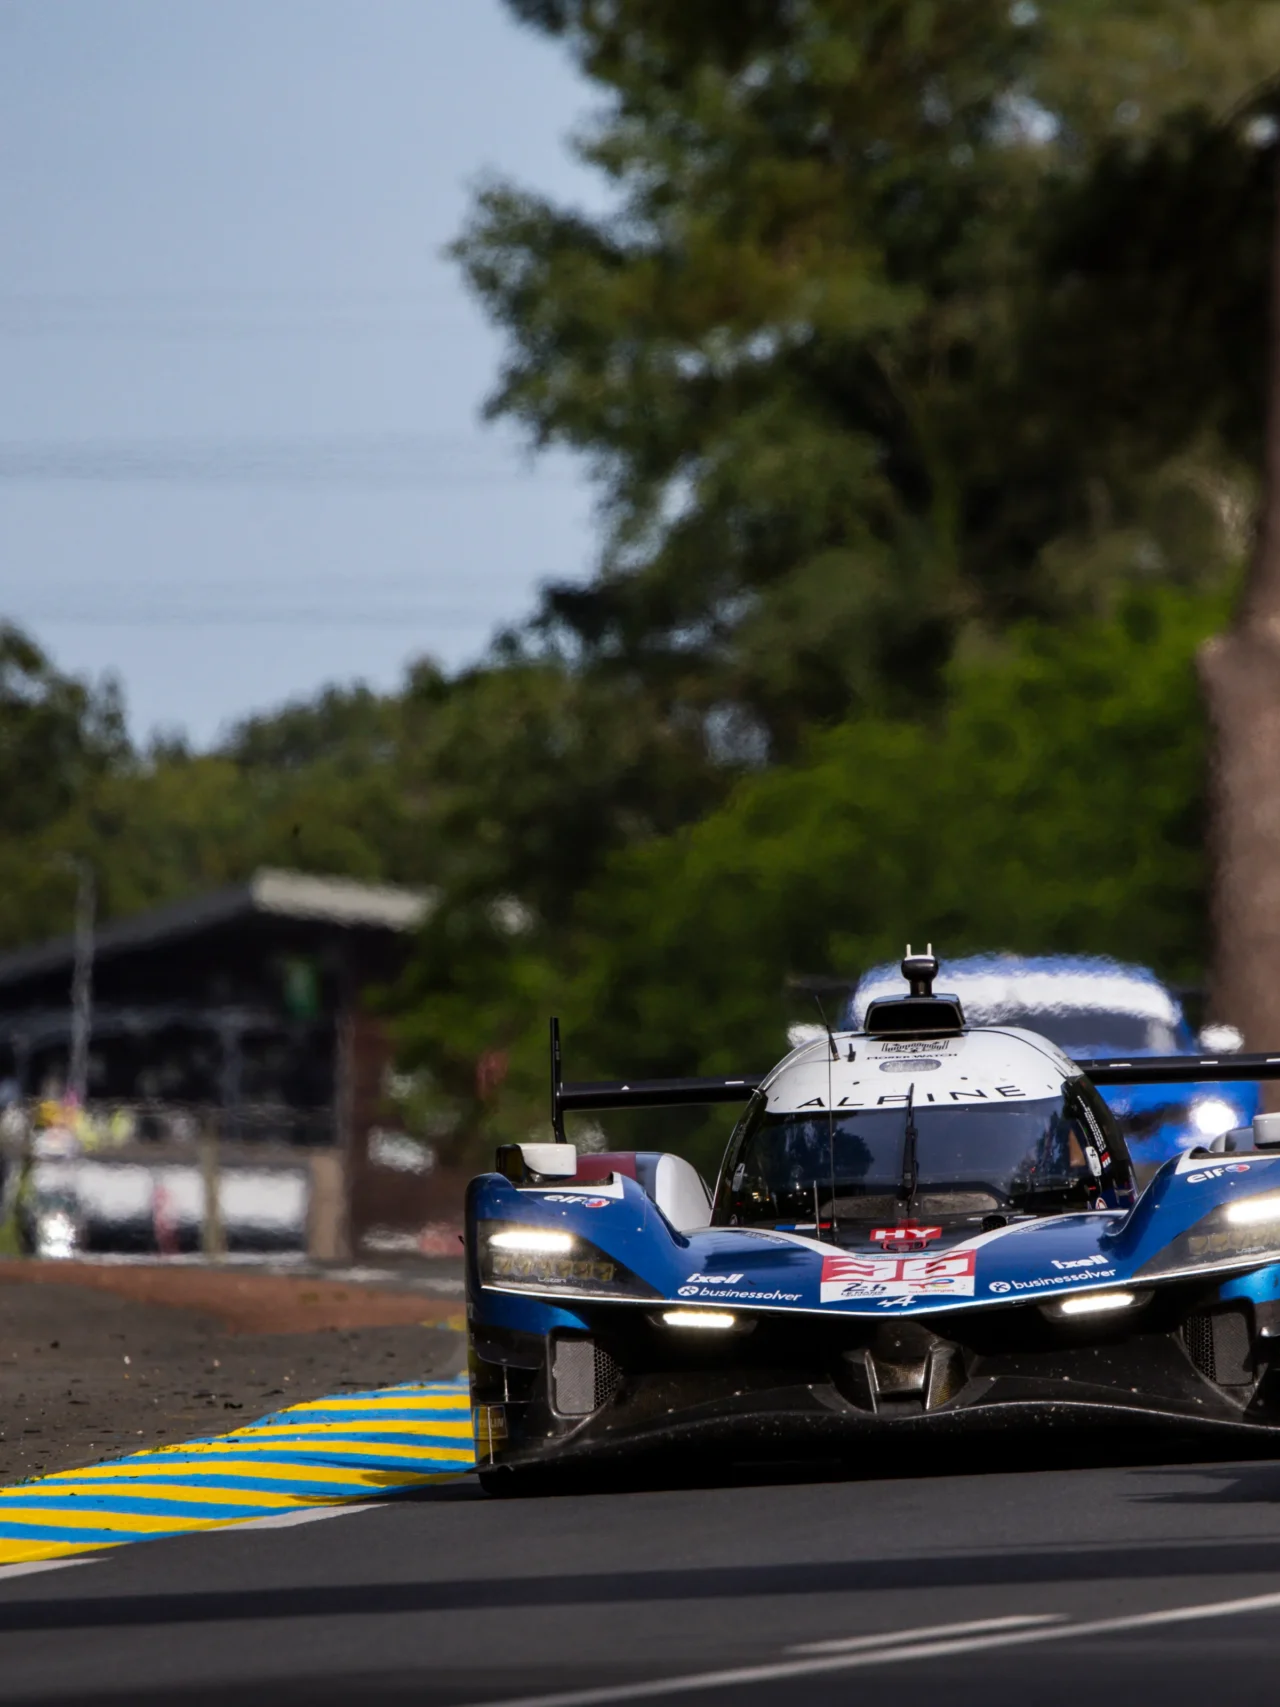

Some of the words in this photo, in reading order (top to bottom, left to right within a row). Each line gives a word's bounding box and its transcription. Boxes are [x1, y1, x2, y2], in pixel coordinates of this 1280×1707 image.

[797, 1085, 1026, 1109] ALPINE
[1187, 1168, 1224, 1183] elf
[875, 1228, 940, 1240] HY
[827, 1250, 972, 1281] 36
[1012, 1269, 1116, 1290] businessolver
[699, 1287, 803, 1301] businessolver
